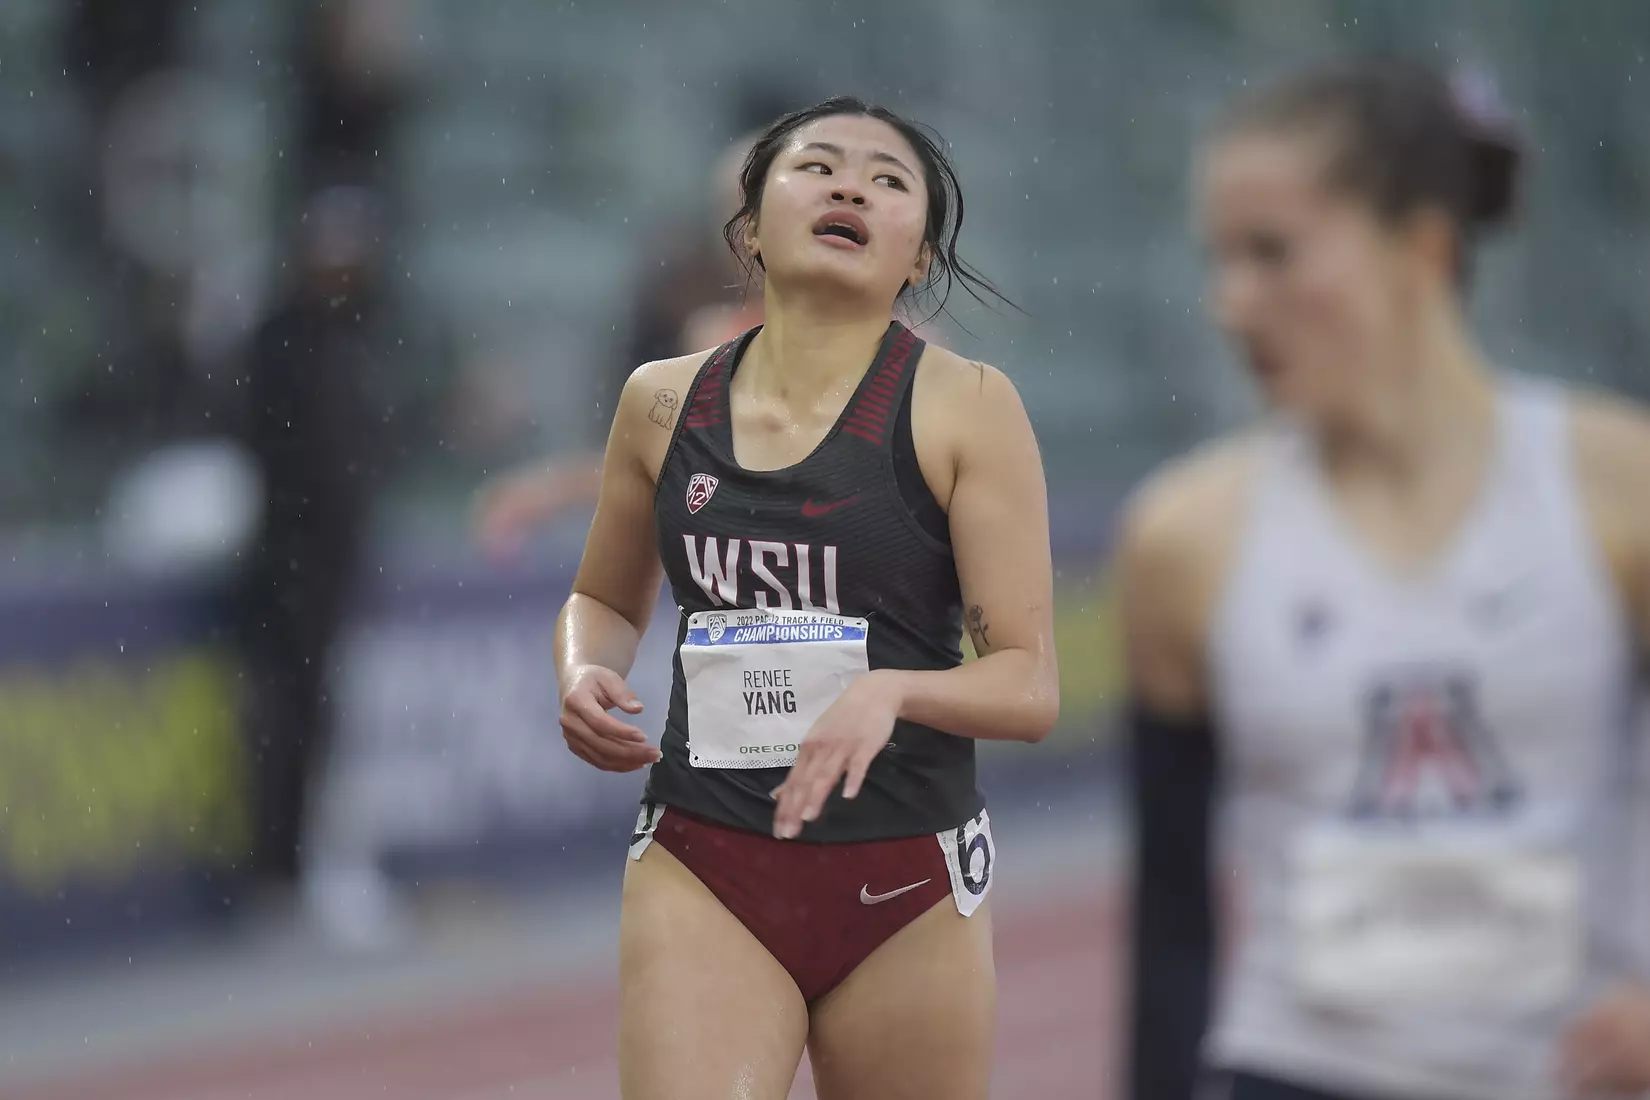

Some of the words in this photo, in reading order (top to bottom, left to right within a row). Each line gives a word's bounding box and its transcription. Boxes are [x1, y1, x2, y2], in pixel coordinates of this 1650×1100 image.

[689, 475, 716, 499] PAC
[690, 491, 706, 506] 12
[682, 534, 841, 614] WSU
[736, 615, 755, 626] 2022
[755, 614, 780, 625] PAC-12
[782, 615, 809, 625] TRACK
[811, 615, 818, 623] &
[820, 616, 845, 626] FIELD
[733, 624, 844, 643] CHAMPIONSHIPS
[743, 669, 793, 689] RENEE
[742, 690, 797, 715] YANG
[956, 814, 991, 896] 6
